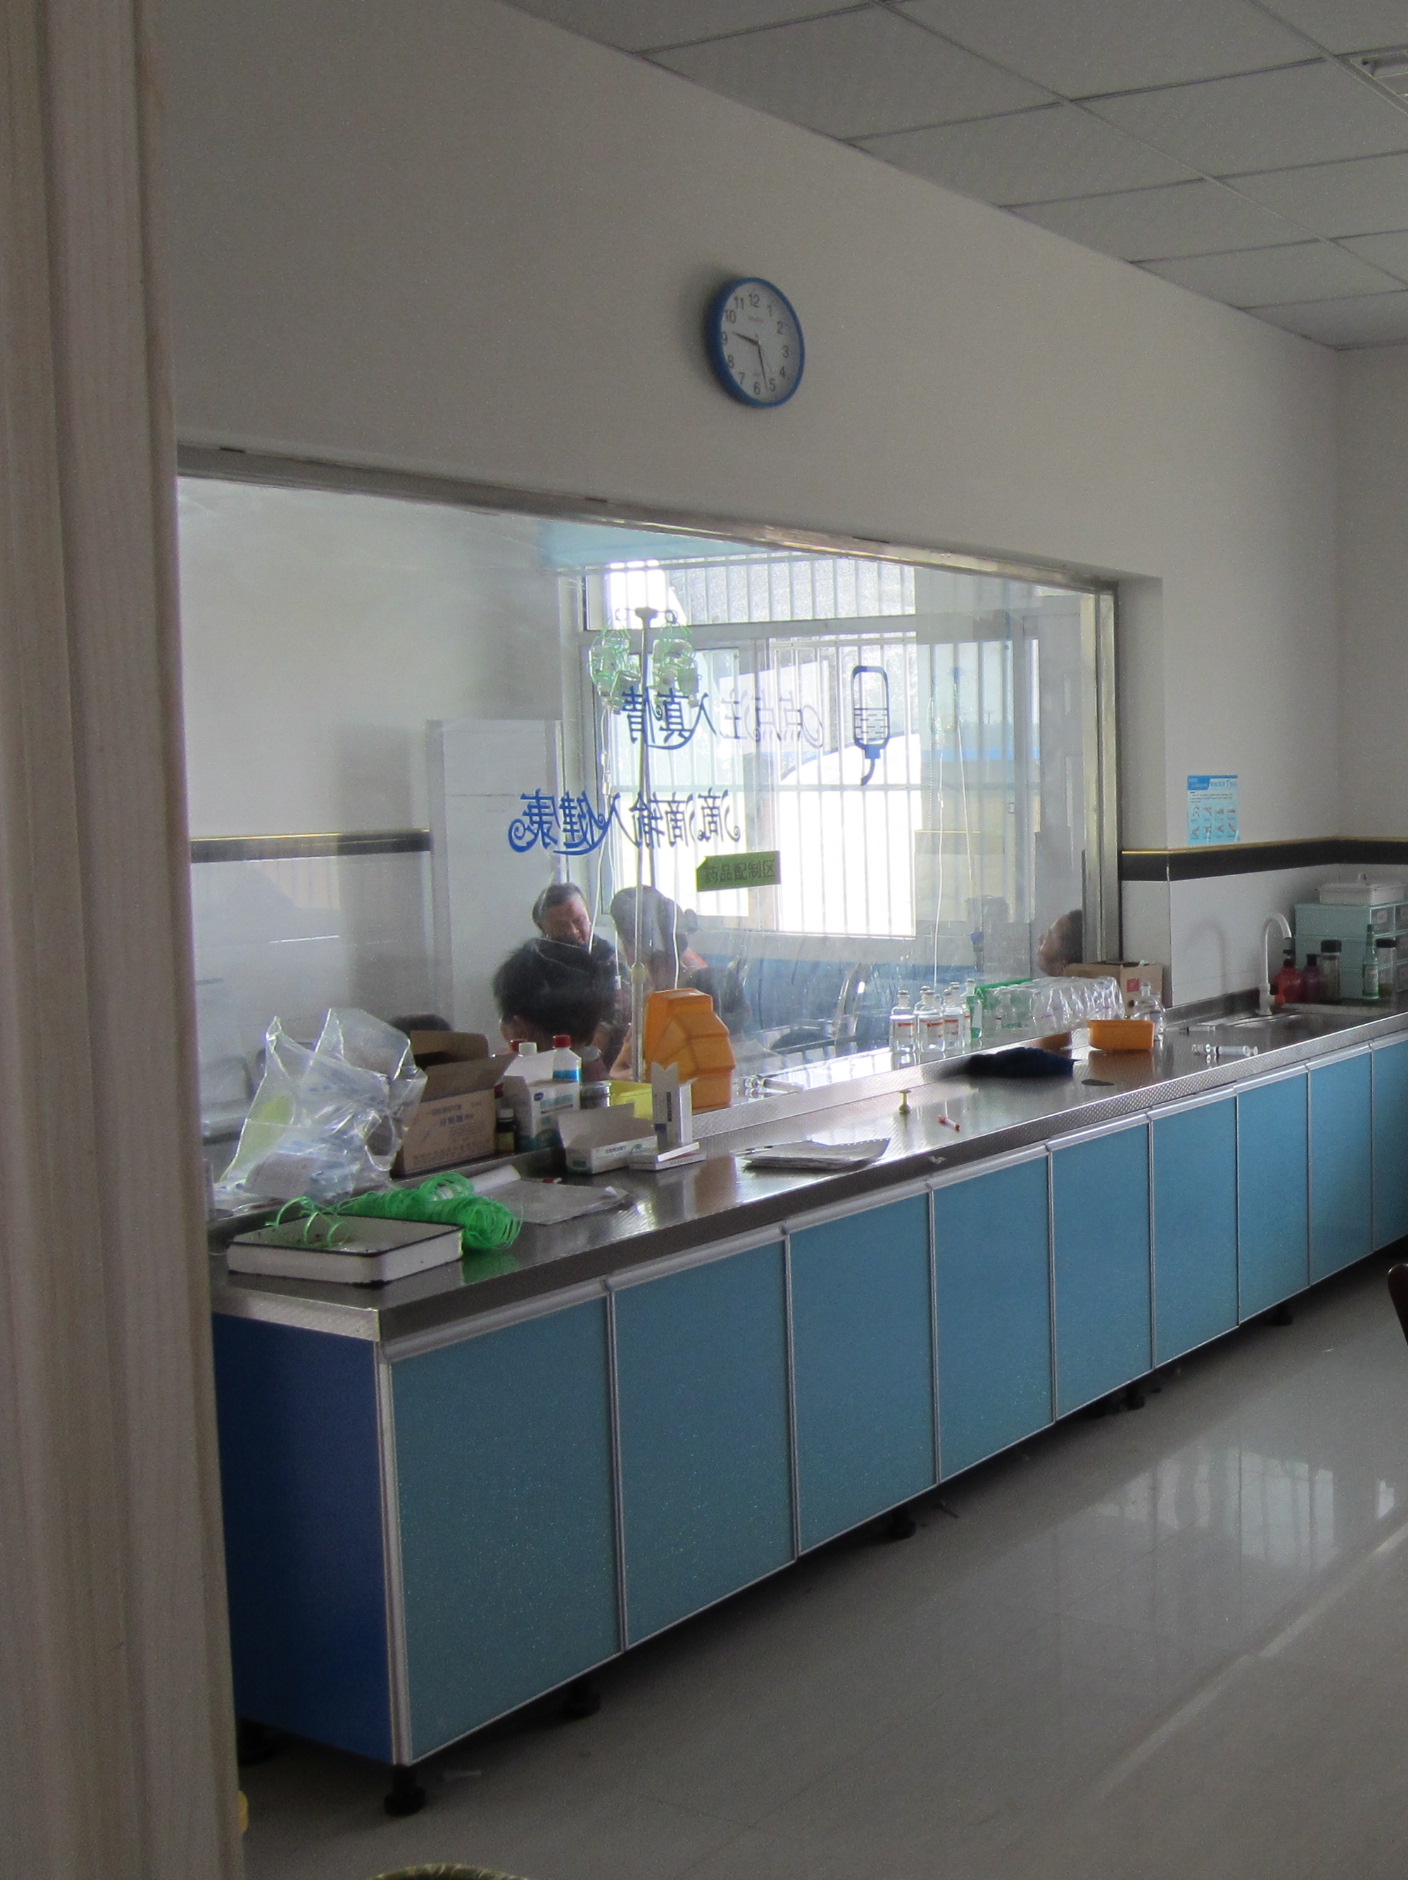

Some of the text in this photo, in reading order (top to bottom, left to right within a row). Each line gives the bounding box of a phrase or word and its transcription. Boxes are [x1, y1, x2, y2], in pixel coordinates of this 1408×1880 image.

[734, 296, 745, 310] 11
[748, 293, 760, 308] 12
[725, 309, 737, 324] 10
[767, 304, 773, 317] 1
[776, 321, 784, 335] 2
[721, 331, 728, 345] 9
[782, 345, 790, 358] 3
[728, 354, 735, 369] 8
[738, 372, 746, 385] 7
[779, 365, 786, 378] 4
[754, 382, 761, 395] 6
[769, 378, 776, 392] 5
[704, 859, 776, 884] 药品配制区
